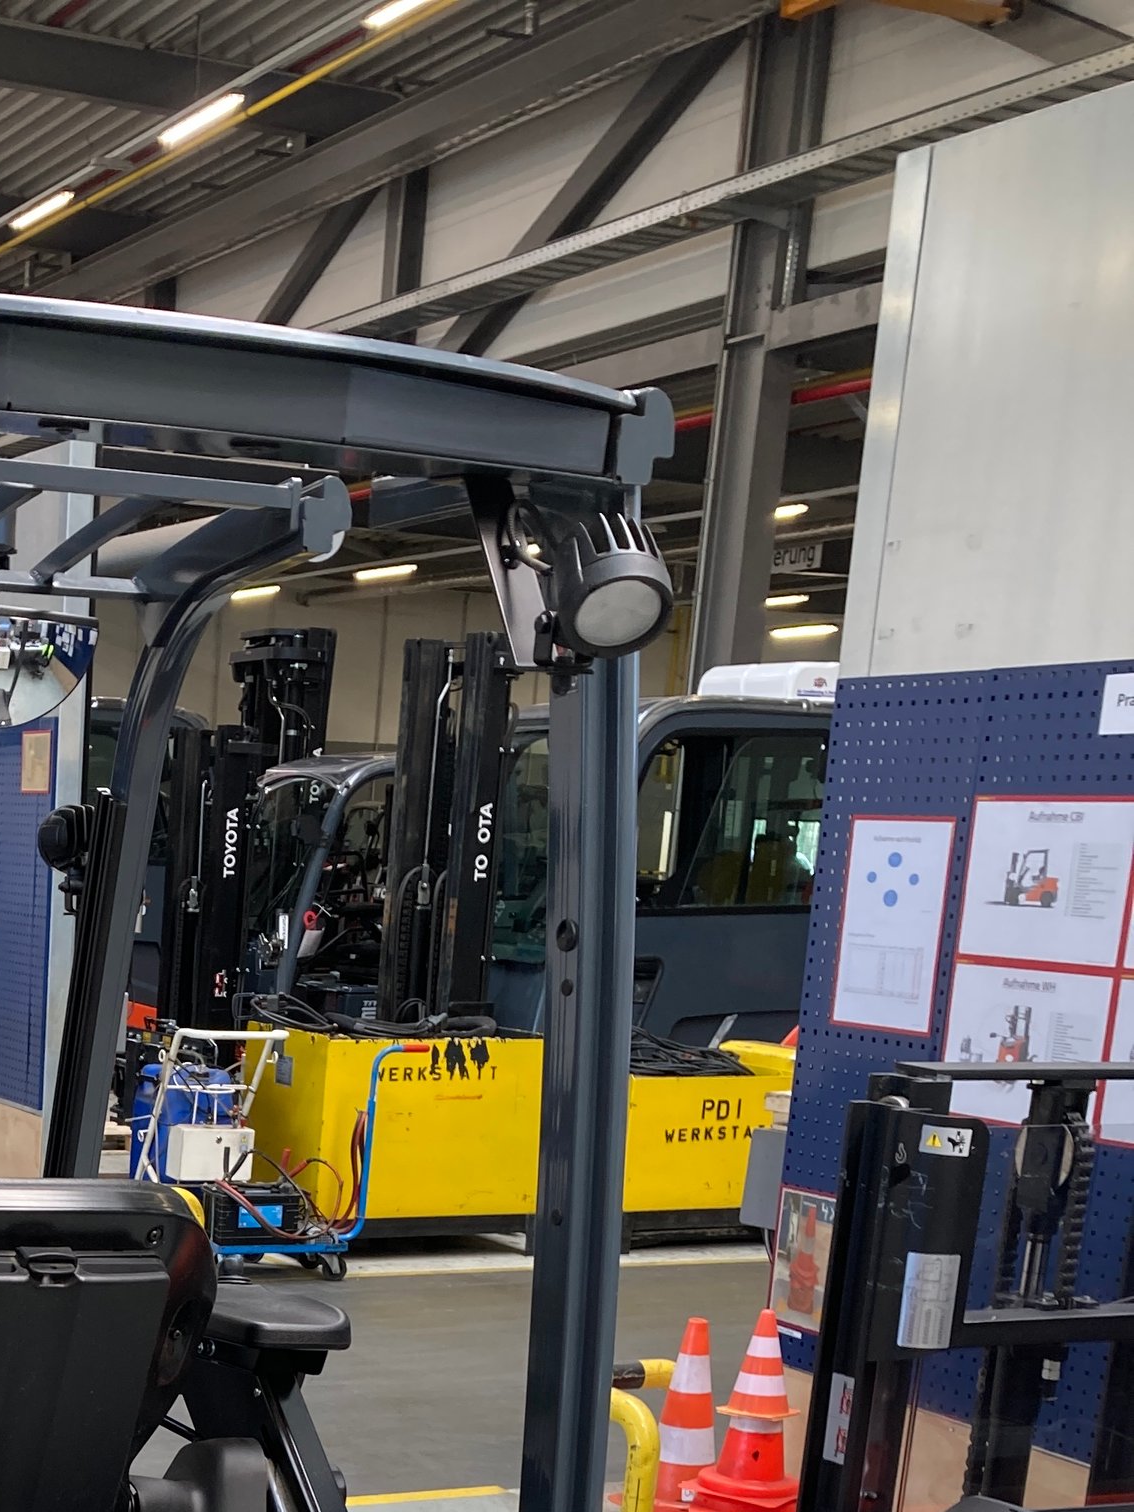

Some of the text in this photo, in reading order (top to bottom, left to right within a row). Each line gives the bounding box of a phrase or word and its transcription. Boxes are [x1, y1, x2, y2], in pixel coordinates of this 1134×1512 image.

[1028, 810, 1069, 823] Aufnahme
[222, 807, 240, 879] TOYOTA
[474, 802, 494, 882] TOOTA
[1002, 978, 1041, 991] Aufnahme
[665, 1124, 766, 1143] WERKSTA
